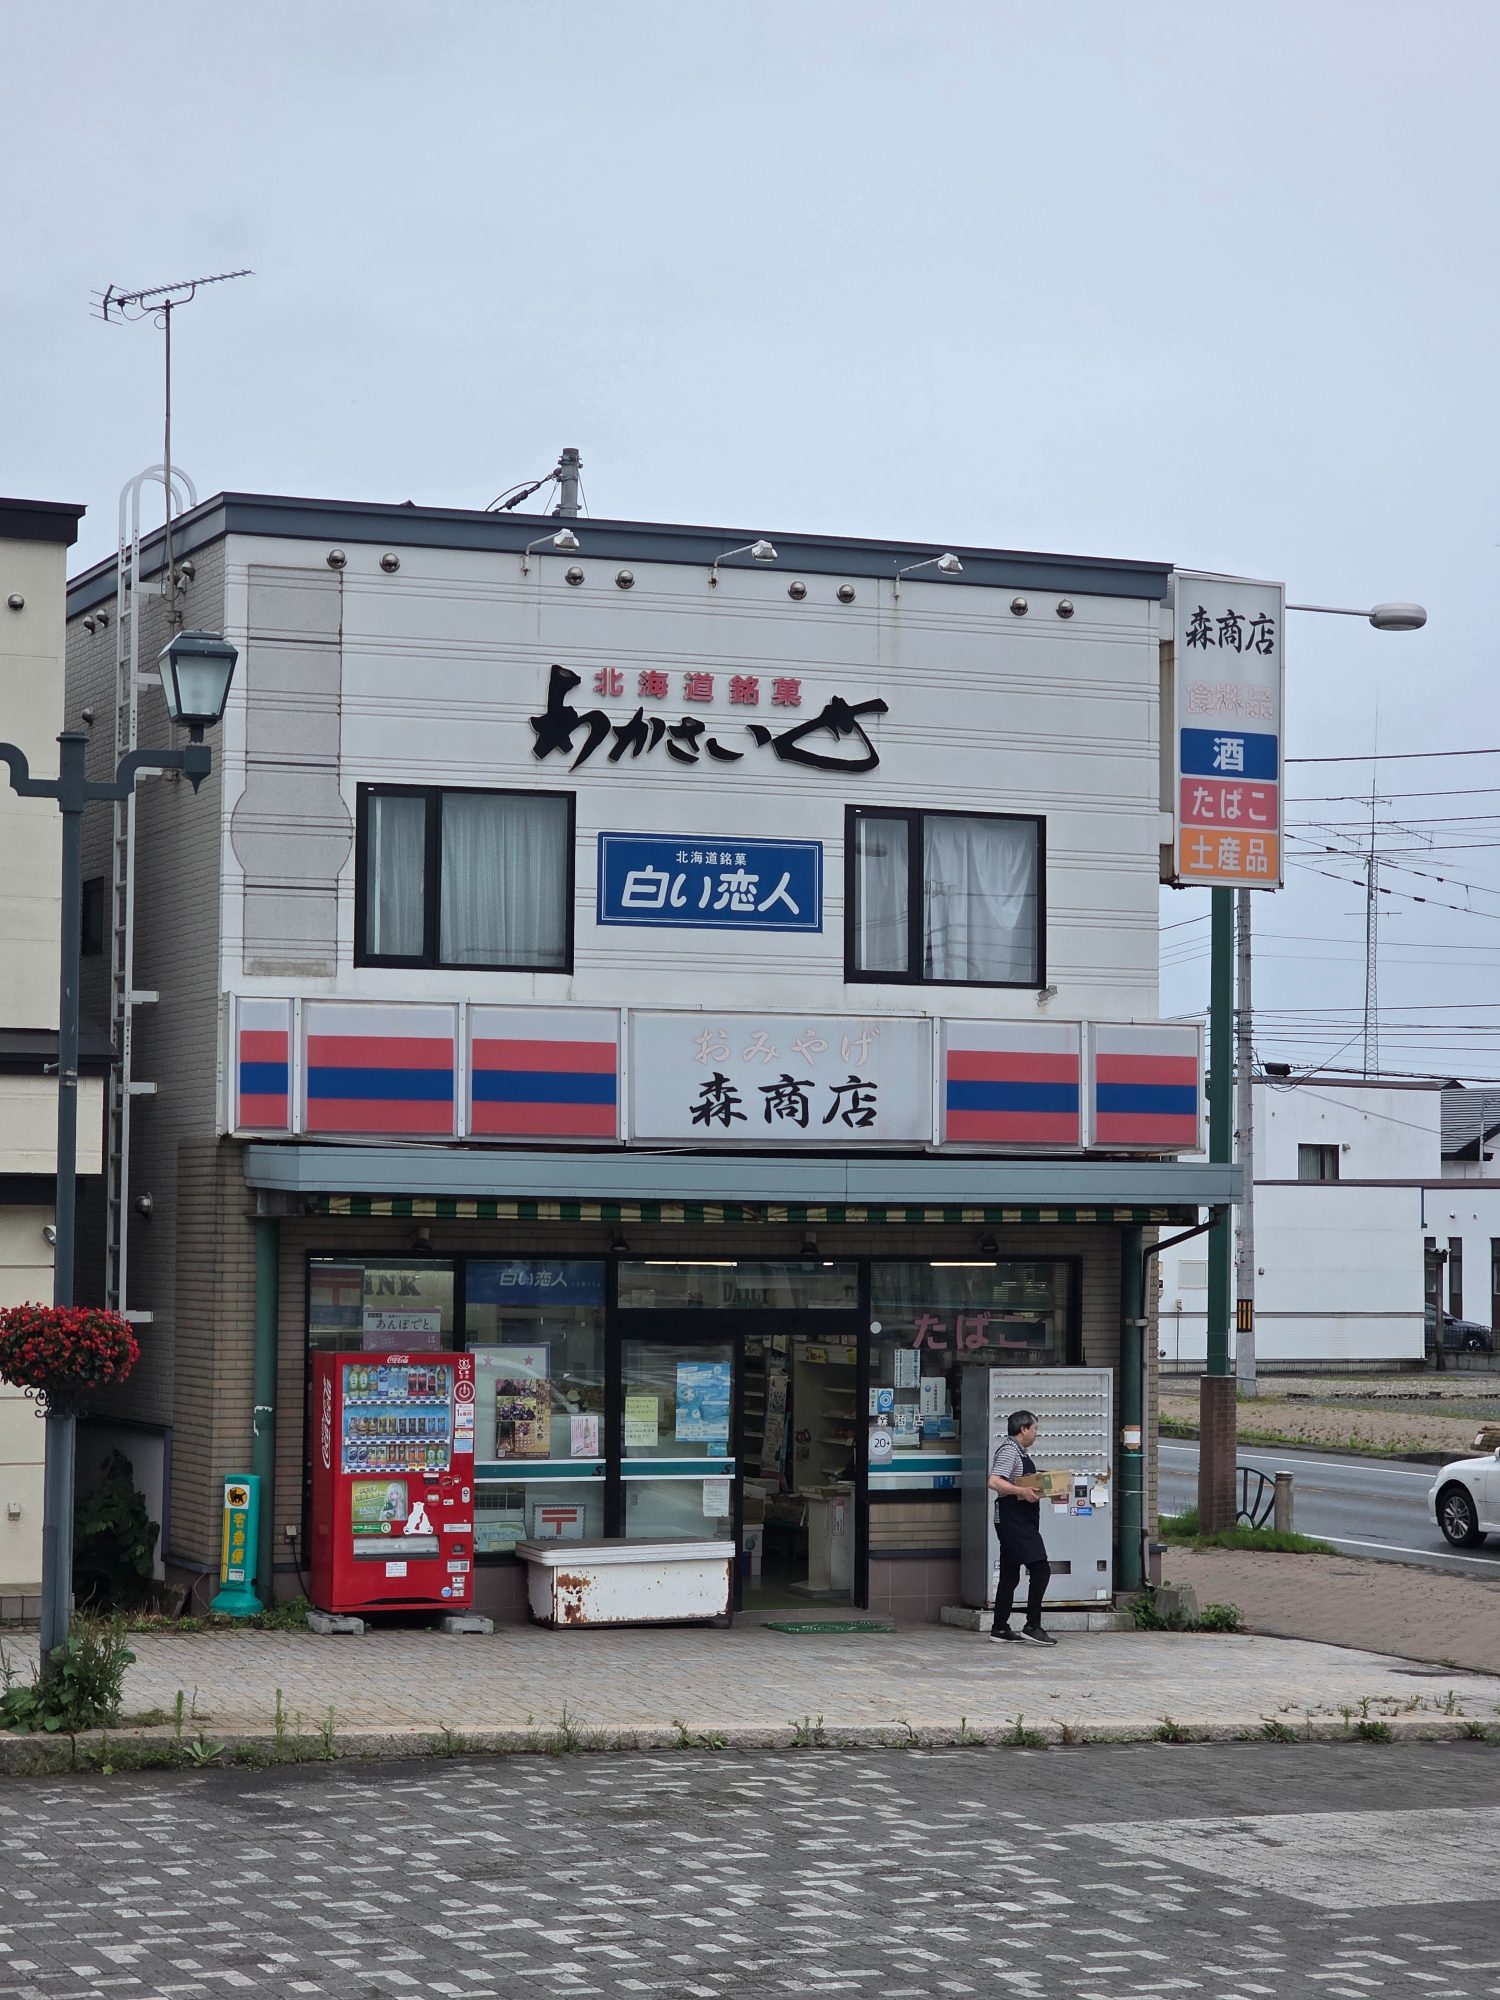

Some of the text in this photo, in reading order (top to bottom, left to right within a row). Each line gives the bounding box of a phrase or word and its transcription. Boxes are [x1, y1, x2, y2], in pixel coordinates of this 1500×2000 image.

[1185, 605, 1275, 655] 森商店
[593, 667, 803, 706] 北海道銘菓
[529, 664, 889, 773] わかさいも
[1212, 737, 1245, 772] 酒
[1192, 786, 1267, 820] たばこ
[676, 850, 747, 866] 北海道銘菓
[1190, 835, 1268, 873] 土産品
[620, 864, 800, 915] 白い恋人
[692, 1026, 881, 1067] おみやげ
[688, 1071, 879, 1129] 森商店
[499, 1270, 568, 1288] 白い恋人
[912, 1311, 1028, 1350] たばこ
[386, 1354, 410, 1364] Coca-Cola
[321, 1373, 332, 1469] Coca-Cola
[876, 1414, 925, 1427] 森商店
[874, 1438, 891, 1448] 20+
